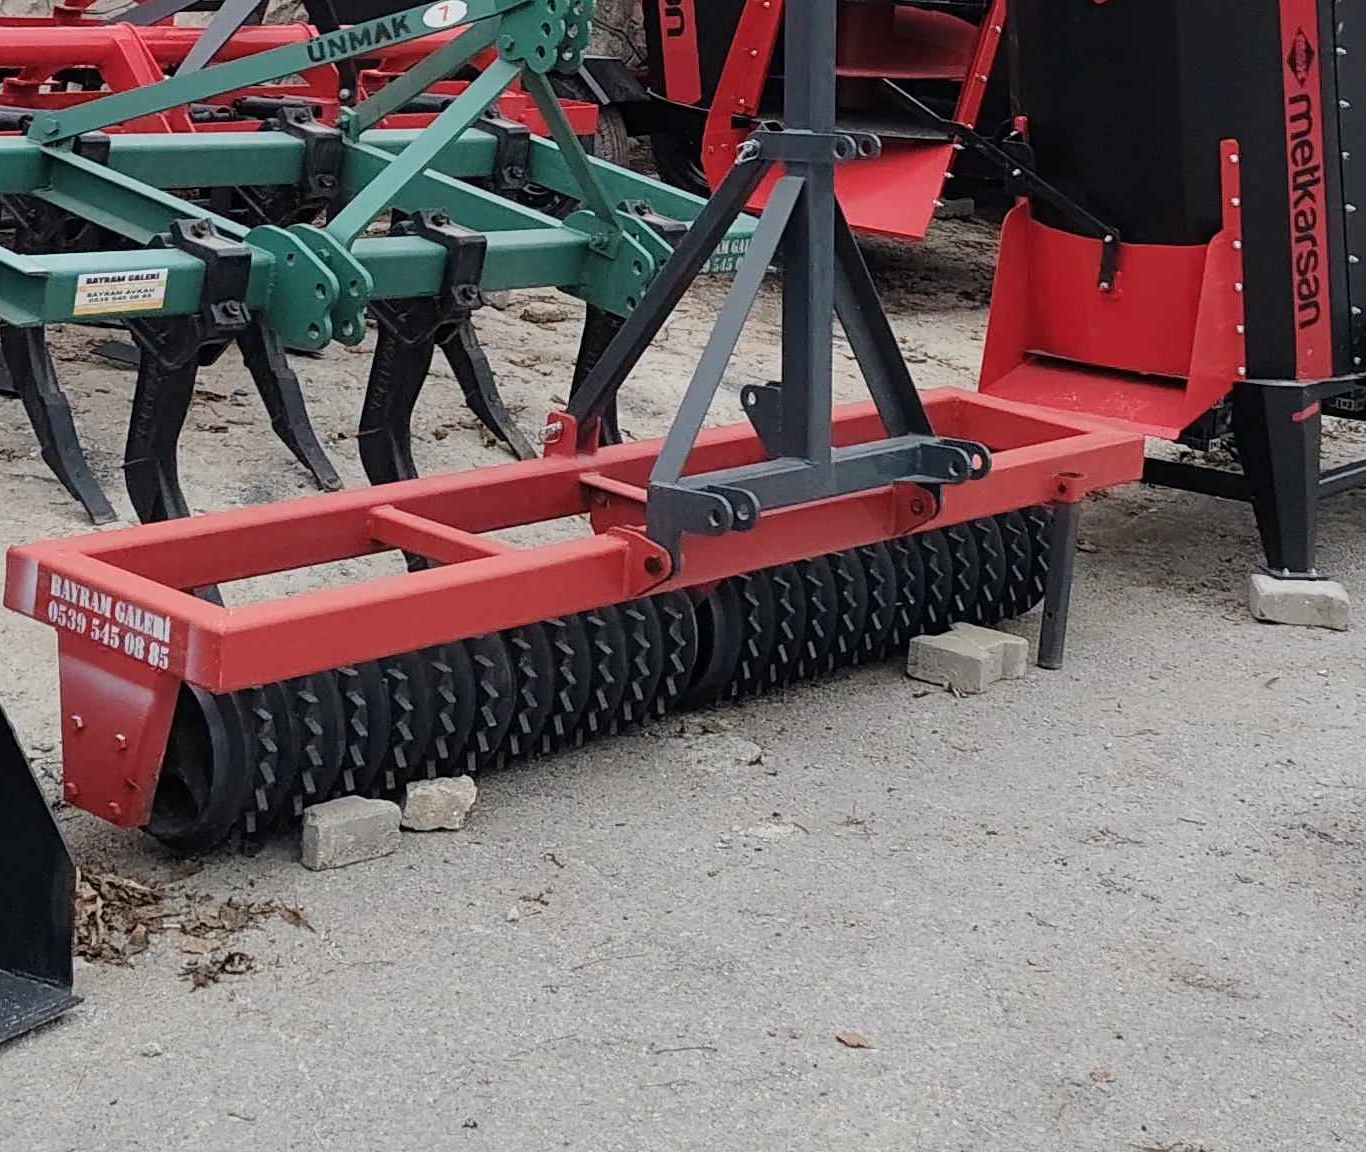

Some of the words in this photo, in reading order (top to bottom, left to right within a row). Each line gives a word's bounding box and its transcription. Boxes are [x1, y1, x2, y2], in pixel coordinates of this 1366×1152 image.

[306, 15, 412, 63] ÜNMAK
[437, 4, 450, 23] 7
[1287, 93, 1322, 329] melkarsan
[85, 275, 126, 285] BAYRAM
[127, 271, 160, 282] GALERİ
[86, 290, 123, 298] BAYRAM
[48, 600, 87, 634] 0539
[91, 618, 120, 649] 545
[123, 631, 145, 660] 08
[148, 642, 169, 669] 85
[50, 573, 112, 618] BAYRAM
[115, 600, 171, 643] GALERİ
